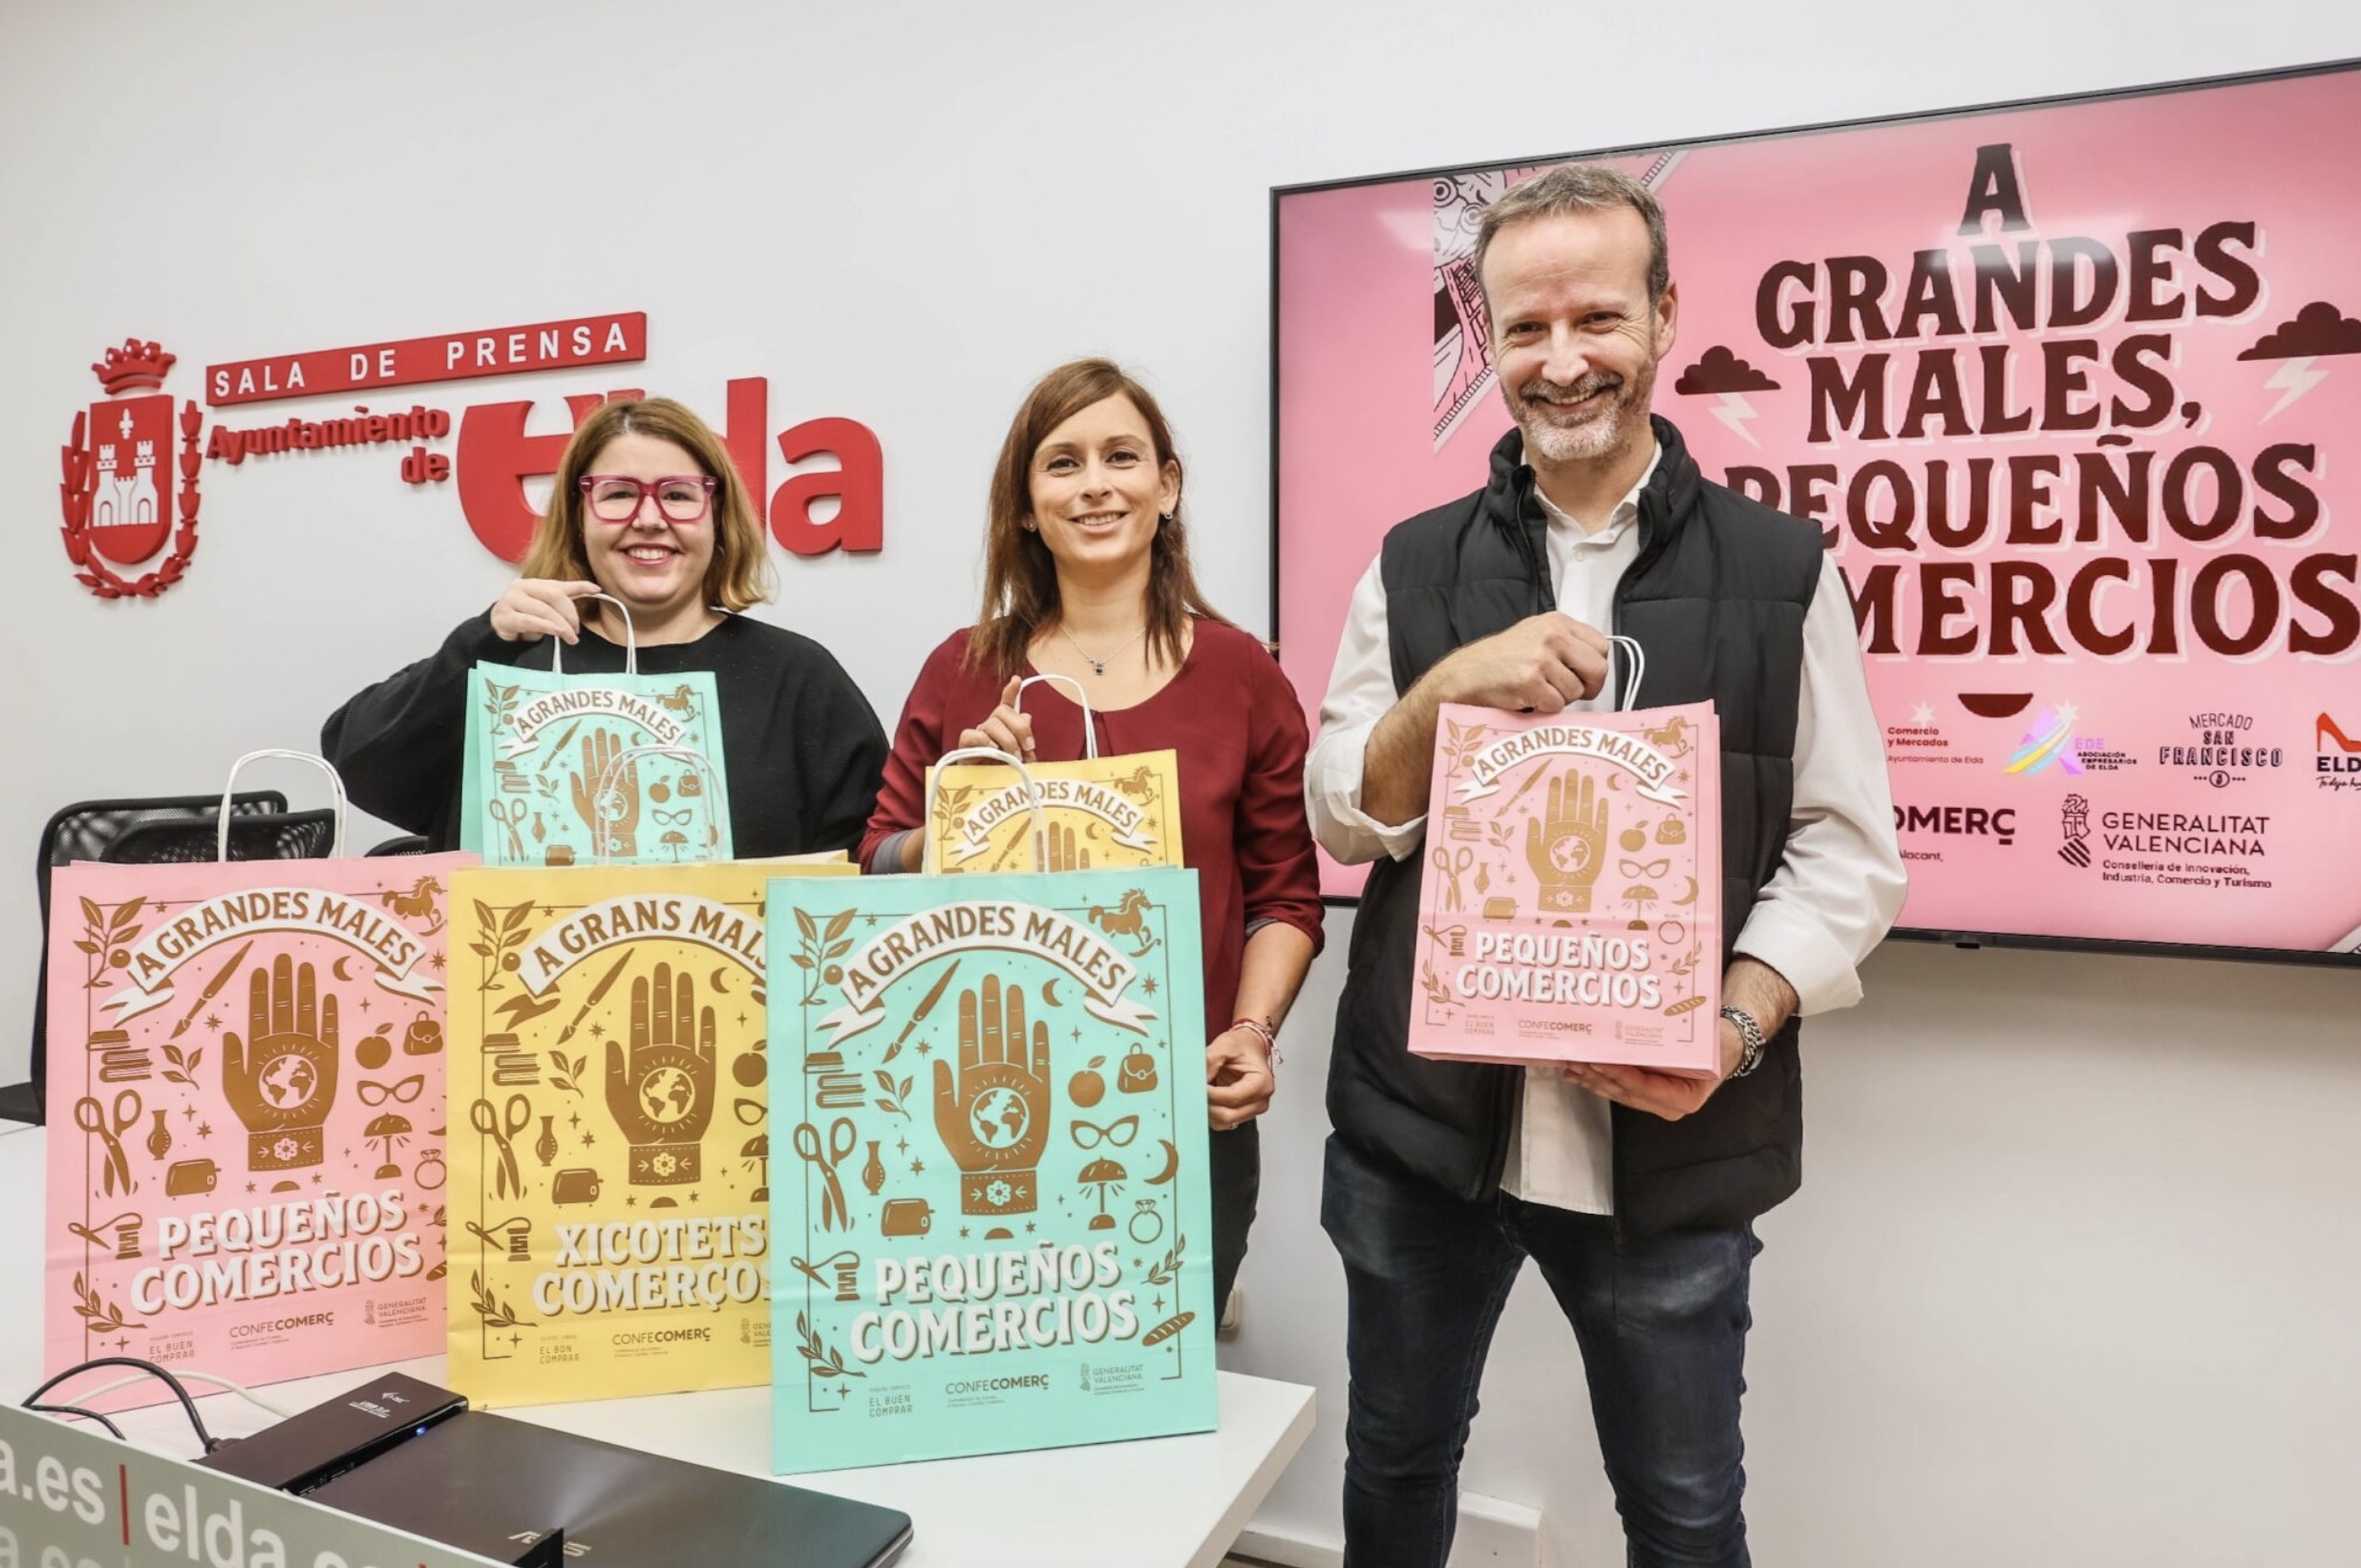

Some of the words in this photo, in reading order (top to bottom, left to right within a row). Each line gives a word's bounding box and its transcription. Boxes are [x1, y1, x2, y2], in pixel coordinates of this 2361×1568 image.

[1957, 142, 2031, 236] A
[1755, 221, 2260, 350] GRANDES
[214, 361, 305, 398] SALA
[351, 350, 395, 380] DE
[447, 322, 627, 371] PRENSA
[1806, 334, 2202, 444] MALES,
[205, 405, 451, 466] Ayuntamiento
[401, 446, 451, 484] de
[1724, 434, 2319, 551] PEQUEÑOS
[1838, 554, 2361, 655] MERCIOS
[516, 717, 534, 734] A
[531, 689, 614, 732] GRANDES
[618, 693, 681, 741] MALES
[1887, 727, 1940, 735] Comercio
[2189, 712, 2254, 731] MERCADO
[1476, 758, 1497, 778] A
[1493, 728, 1594, 769] GRANDES
[1596, 732, 1668, 782] MALES
[1887, 739, 1894, 748] y
[1896, 738, 1949, 747] Mercados
[2074, 738, 2105, 750] EDE
[2202, 731, 2235, 745] SAN
[1887, 754, 1949, 765] Ayuntamiento
[1950, 755, 1963, 764] de
[1965, 755, 1984, 765] Elda
[2159, 747, 2284, 768] FRANCISCO
[2316, 756, 2361, 773] ELD
[968, 819, 985, 837] A
[980, 781, 1070, 825] GRANDES
[1074, 784, 1138, 829] MALES
[2101, 811, 2270, 836] GENERALITAT
[2103, 834, 2265, 857] VALENCIANA
[2102, 871, 2155, 884] Industria,
[2157, 874, 2212, 886] Comercio
[2214, 878, 2221, 888] y
[2223, 876, 2272, 889] Turismo
[2103, 859, 2164, 871] Conselleria
[2167, 862, 2182, 872] de
[2184, 861, 2251, 876] Innovación,
[137, 953, 164, 981] A
[155, 891, 310, 962] GRANDES
[316, 897, 417, 968] MALES
[533, 945, 564, 978] A
[559, 901, 682, 955] GRANS
[845, 967, 874, 999] A
[866, 904, 1015, 978] GRANDES
[1024, 910, 1128, 992] MALES
[1474, 931, 1651, 971] PEQUEÑOS
[1455, 964, 1664, 1009] COMERCIOS
[1518, 1019, 1592, 1035] CONFECOMERÇ
[156, 1189, 409, 1261] PEQUEÑOS
[554, 1214, 768, 1268] XICOTETS
[130, 1232, 423, 1316] COMERCIOS
[874, 1240, 1123, 1306] PEQUEÑOS
[229, 1311, 334, 1339] CONFECOMERÇ
[612, 1326, 712, 1347] CONFECOMERÇ
[849, 1289, 1139, 1364] COMERCIOS
[149, 1345, 161, 1354] EL
[540, 1346, 551, 1355] EL
[869, 1397, 882, 1408] EL
[884, 1394, 911, 1406] BUEN
[946, 1373, 1050, 1395] CONFECOMERÇ
[869, 1405, 913, 1418] COMPRAR
